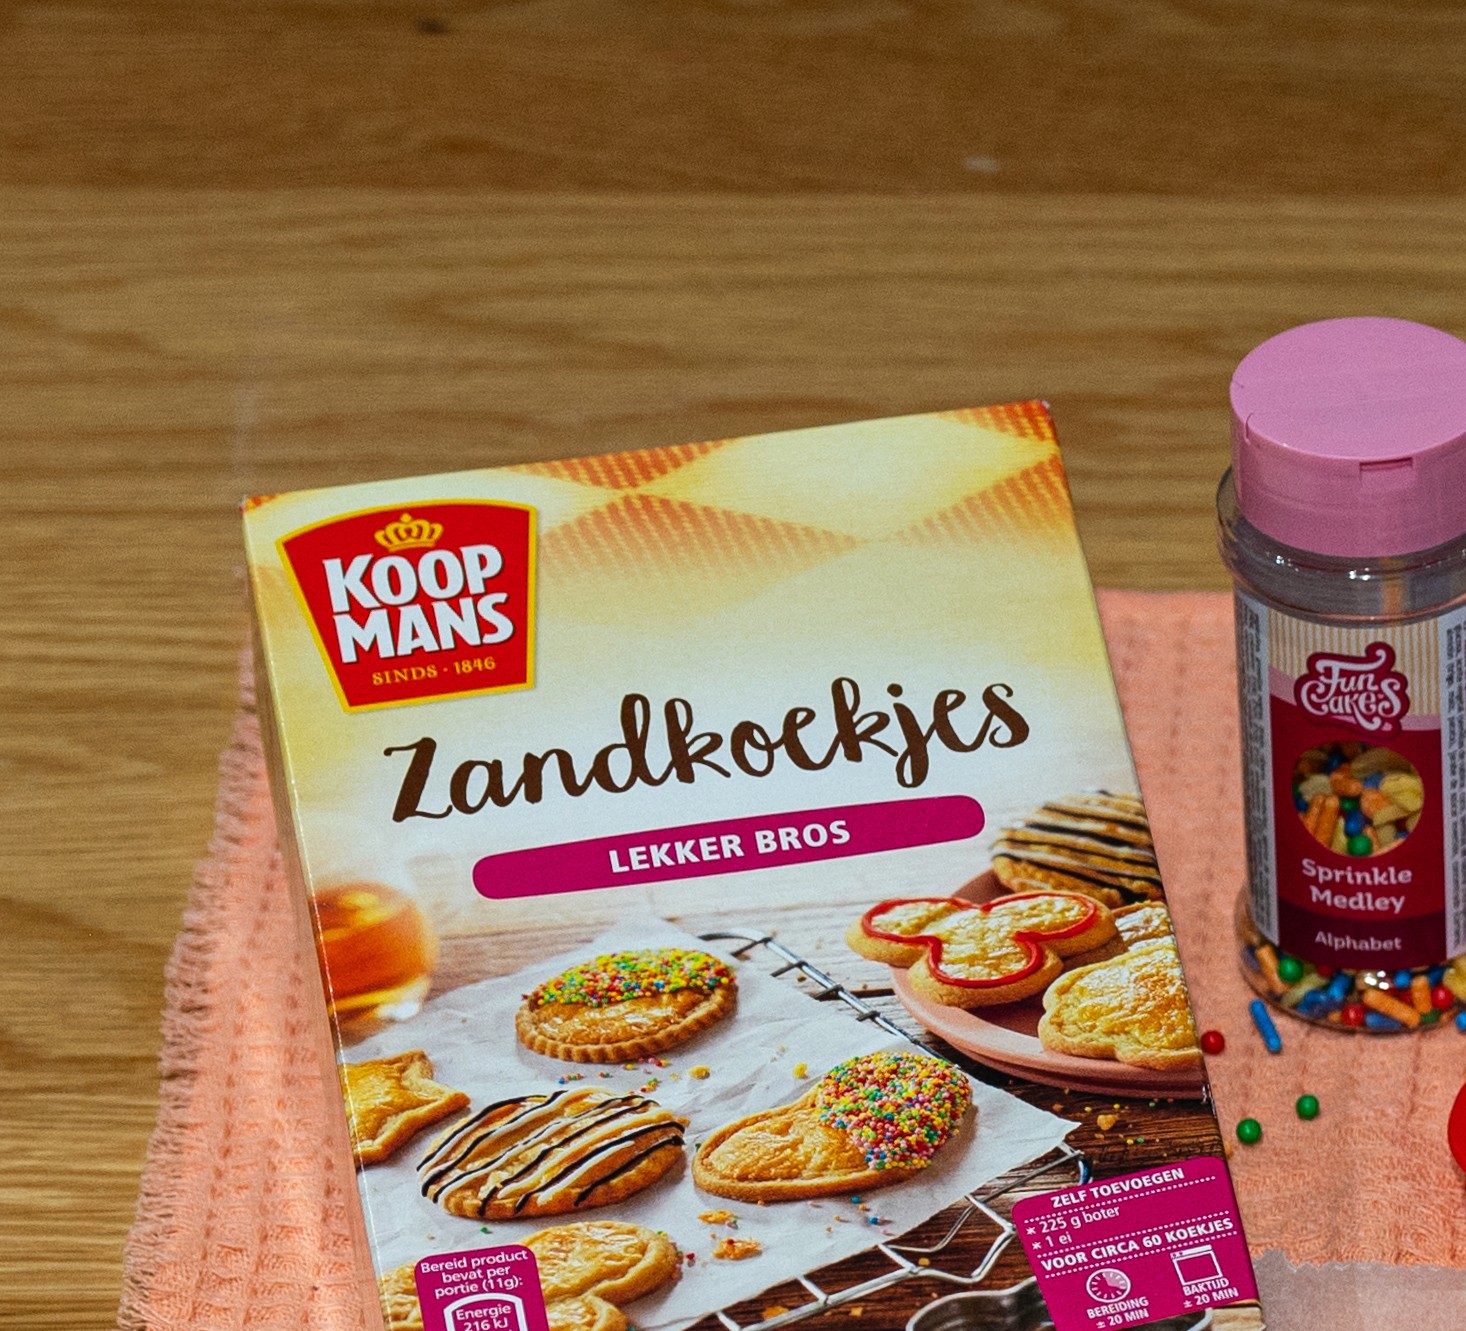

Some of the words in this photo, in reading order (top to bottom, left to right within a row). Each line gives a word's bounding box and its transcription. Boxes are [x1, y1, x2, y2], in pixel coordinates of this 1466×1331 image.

[322, 543, 505, 615] KOOP
[332, 592, 515, 664] MANS
[372, 662, 439, 687] SINDS
[453, 655, 497, 676] 1846
[1315, 649, 1387, 703] Fun
[383, 676, 1030, 823] Zandkoekjes
[608, 832, 746, 874] LEKKER
[757, 820, 852, 855] BROS
[1301, 857, 1413, 887] Sprinkle
[1310, 885, 1406, 914] Medley
[1314, 930, 1402, 953] Alphabet
[1050, 1191, 1088, 1209] ZELF
[1089, 1167, 1185, 1199] TOEVOEGEN
[1038, 1215, 1068, 1234] 225
[1071, 1214, 1082, 1230] g
[1081, 1205, 1121, 1226] boter
[1041, 1251, 1089, 1272] VOOR
[1091, 1240, 1141, 1261] CIRCA
[1142, 1235, 1163, 1249] 60
[1165, 1217, 1235, 1244] KOEKJES
[1045, 1236, 1054, 1249] 1
[1058, 1231, 1073, 1246] ei
[420, 1256, 468, 1274] Bereid
[471, 1249, 529, 1268] product
[441, 1269, 483, 1284] bevat
[486, 1265, 511, 1281] per
[434, 1280, 479, 1300] portie
[482, 1275, 524, 1293] (11g):
[1182, 1277, 1230, 1297] BAKTIJD
[1194, 1294, 1211, 1307] 20
[1212, 1287, 1239, 1302] MIN
[456, 1303, 512, 1321] Energie
[1087, 1296, 1149, 1320] BEREIDING
[1108, 1315, 1124, 1328] 20
[1125, 1309, 1149, 1324] MIN
[493, 1316, 508, 1330] kJ
